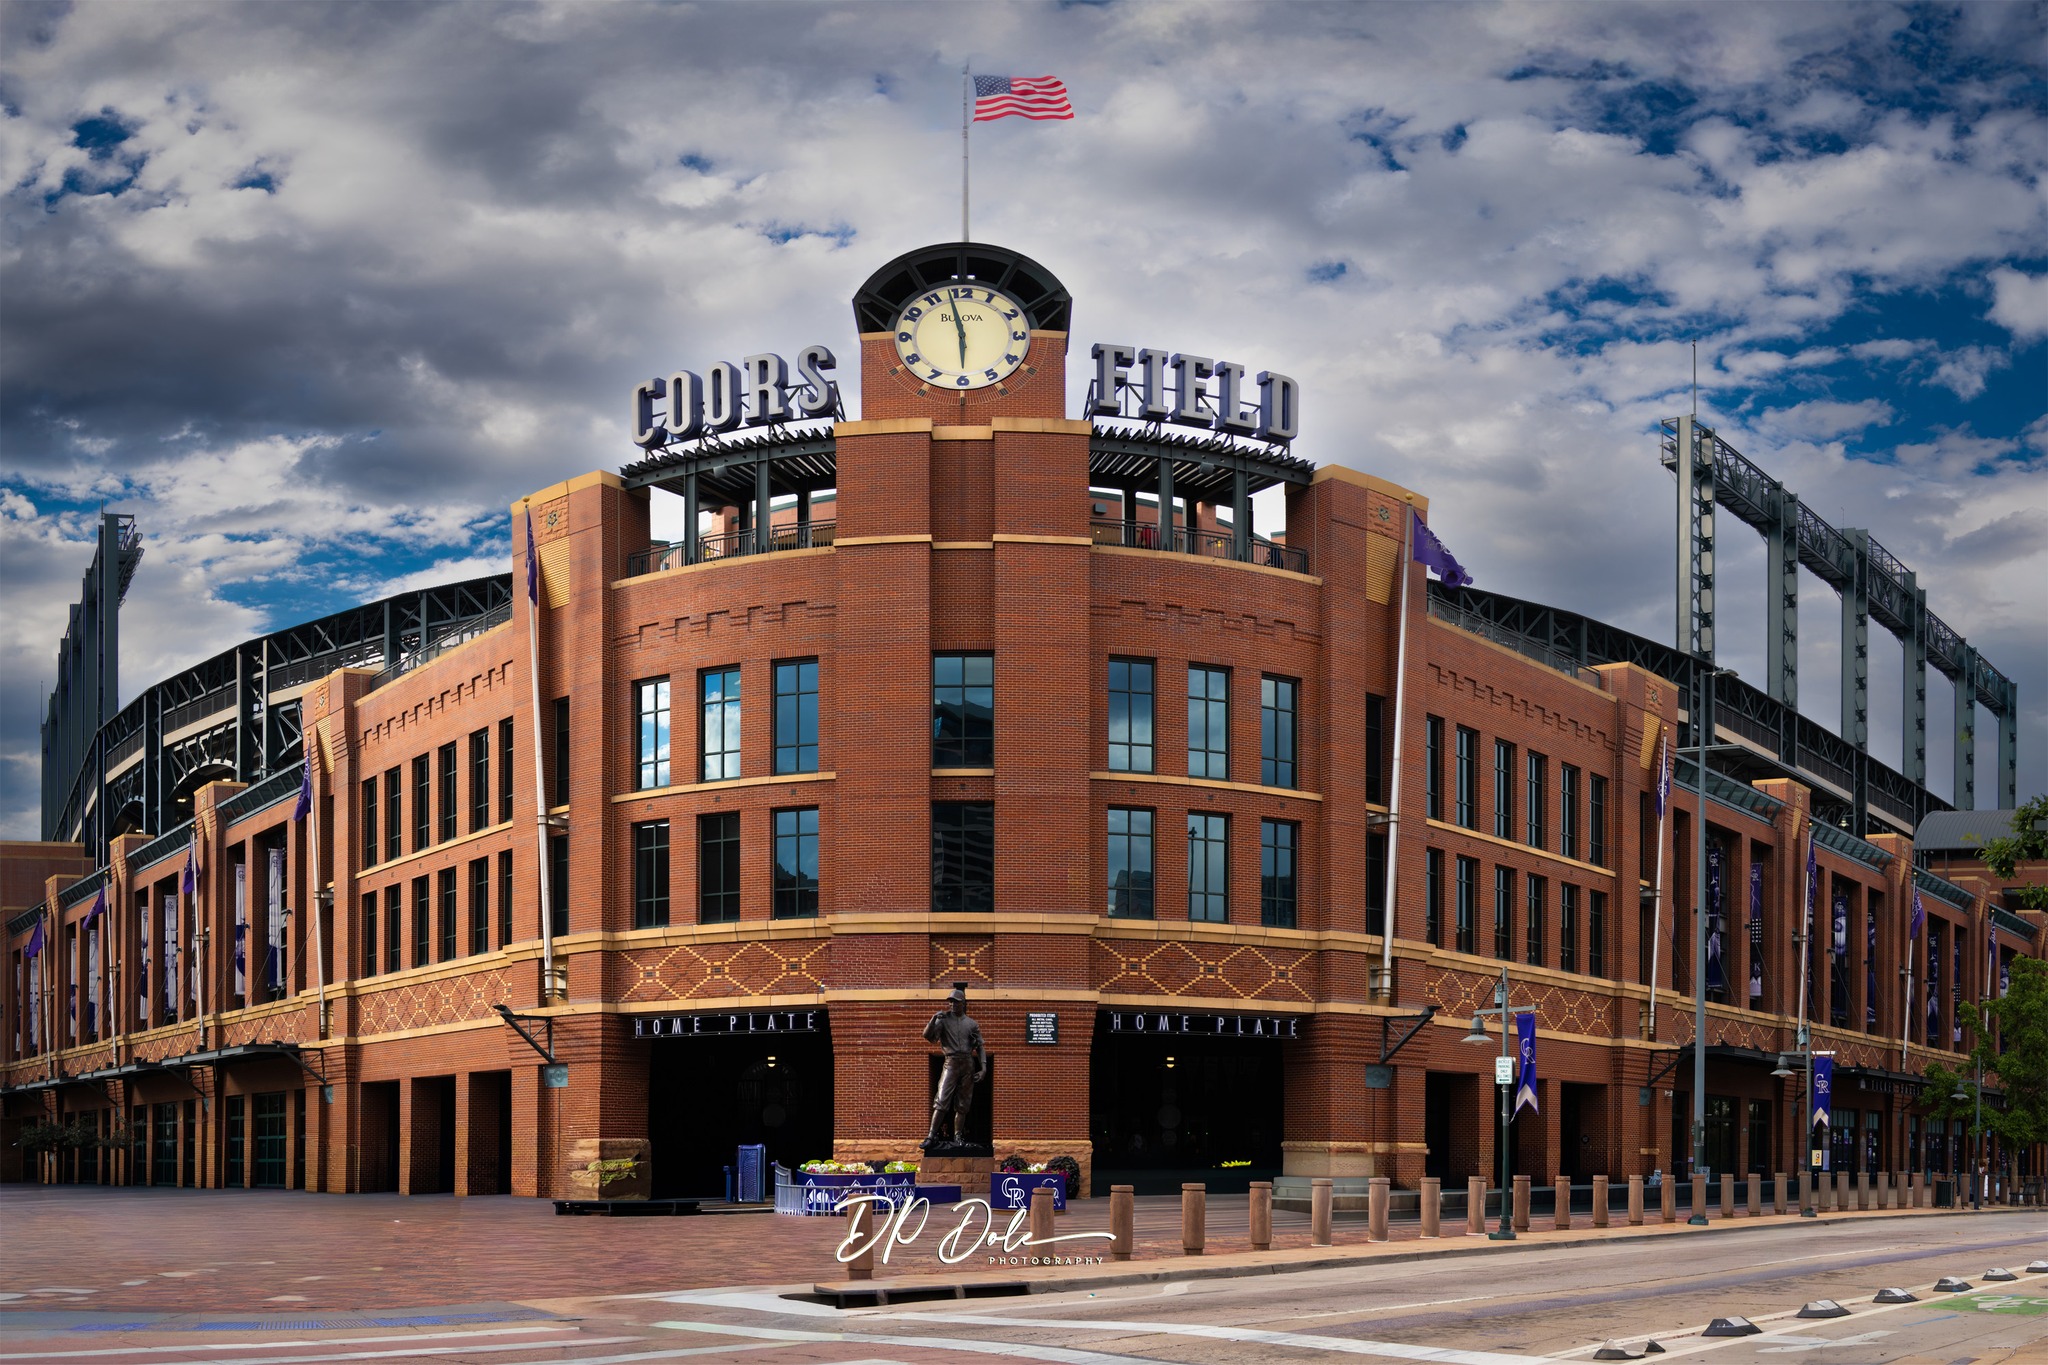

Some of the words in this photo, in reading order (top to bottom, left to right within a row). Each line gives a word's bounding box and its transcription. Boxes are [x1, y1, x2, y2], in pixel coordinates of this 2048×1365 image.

[924, 292, 942, 306] 11
[951, 287, 973, 299] 12
[985, 292, 996, 304] 1
[903, 307, 923, 323] 10
[941, 313, 983, 322] BUOVA
[1003, 308, 1019, 321] 2
[898, 331, 912, 343] 9
[1012, 330, 1026, 342] 3
[905, 353, 920, 365] 8
[1004, 353, 1019, 366] 4
[927, 368, 943, 380] 7
[984, 368, 999, 381] 5
[956, 375, 970, 387] 6
[631, 345, 837, 449] COORS
[1091, 343, 1300, 440] FIELD
[635, 1017, 701, 1036] HOME
[729, 1013, 814, 1031] PLATE
[1113, 1014, 1189, 1031] HOME
[1216, 1017, 1297, 1036] PLATE
[1001, 1176, 1028, 1209] CR
